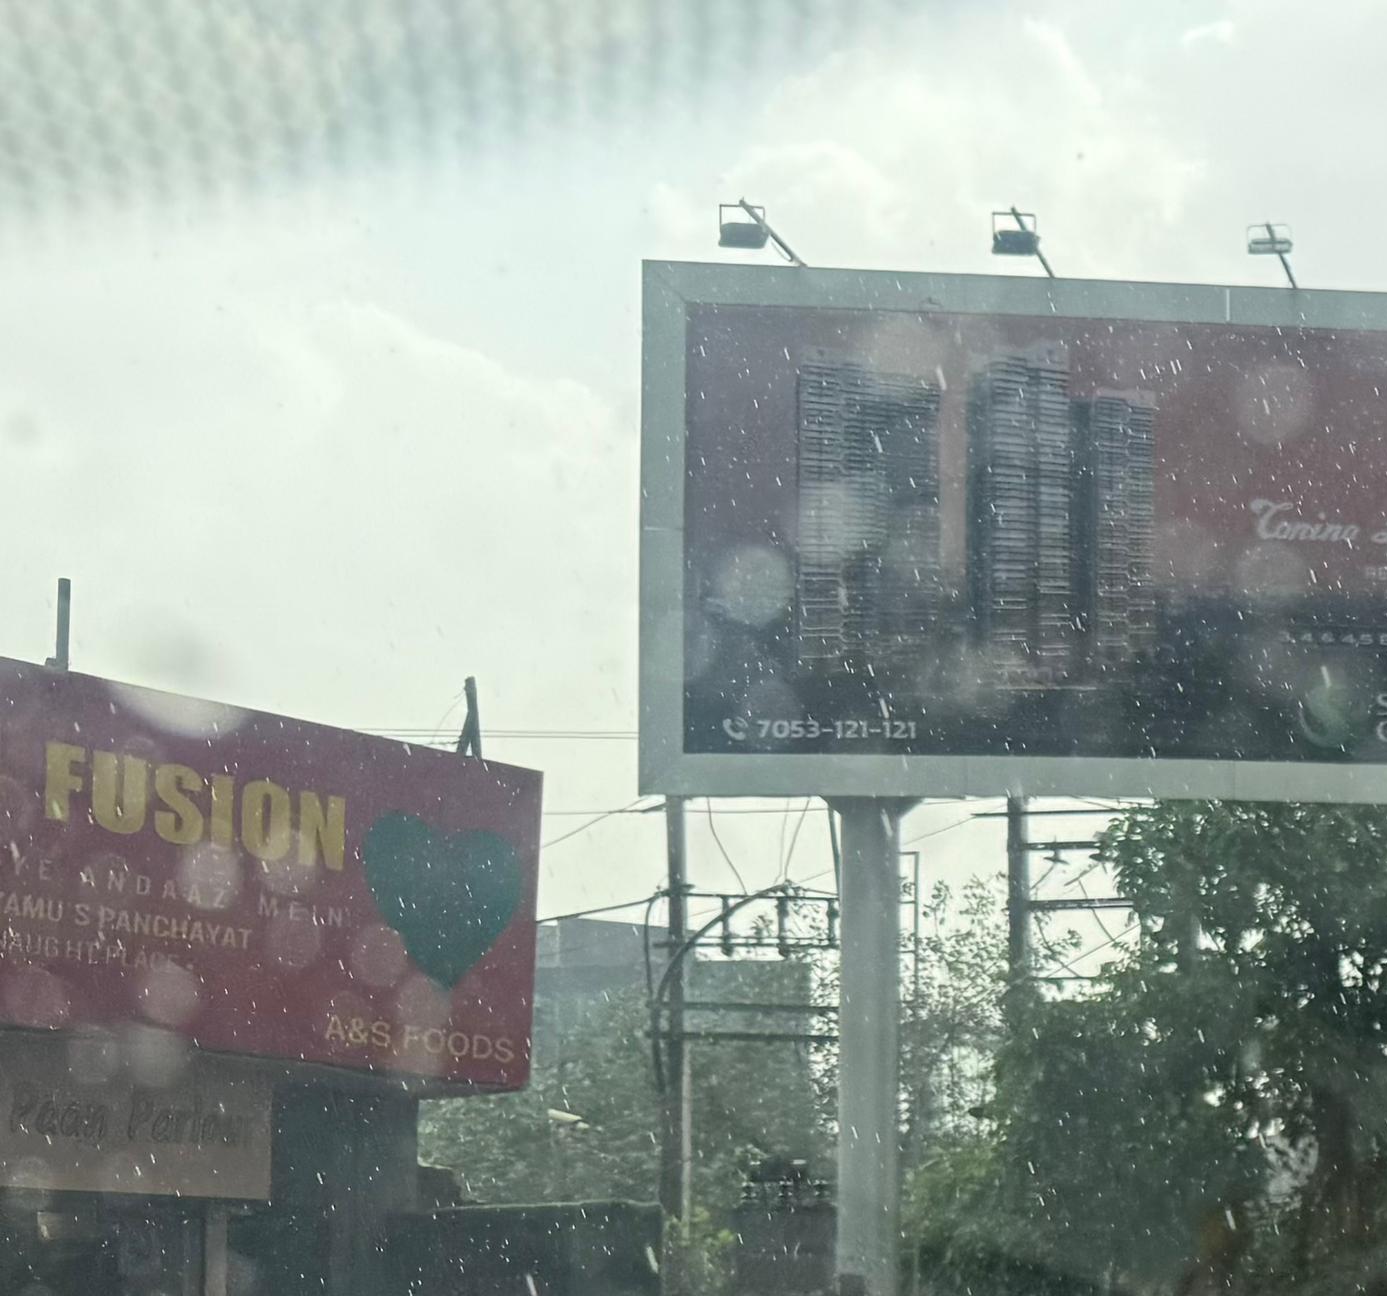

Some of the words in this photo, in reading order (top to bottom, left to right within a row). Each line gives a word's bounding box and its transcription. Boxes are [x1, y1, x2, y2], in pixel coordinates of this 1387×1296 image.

[1250, 499, 1359, 542] Tonino
[756, 719, 917, 739] 7053-121-121
[44, 741, 346, 871] FUSION
[80, 866, 226, 909] ANDAAZ
[99, 904, 253, 949] PANCHAYAT
[325, 1014, 391, 1047] A&S
[403, 1024, 515, 1063] FOODS
